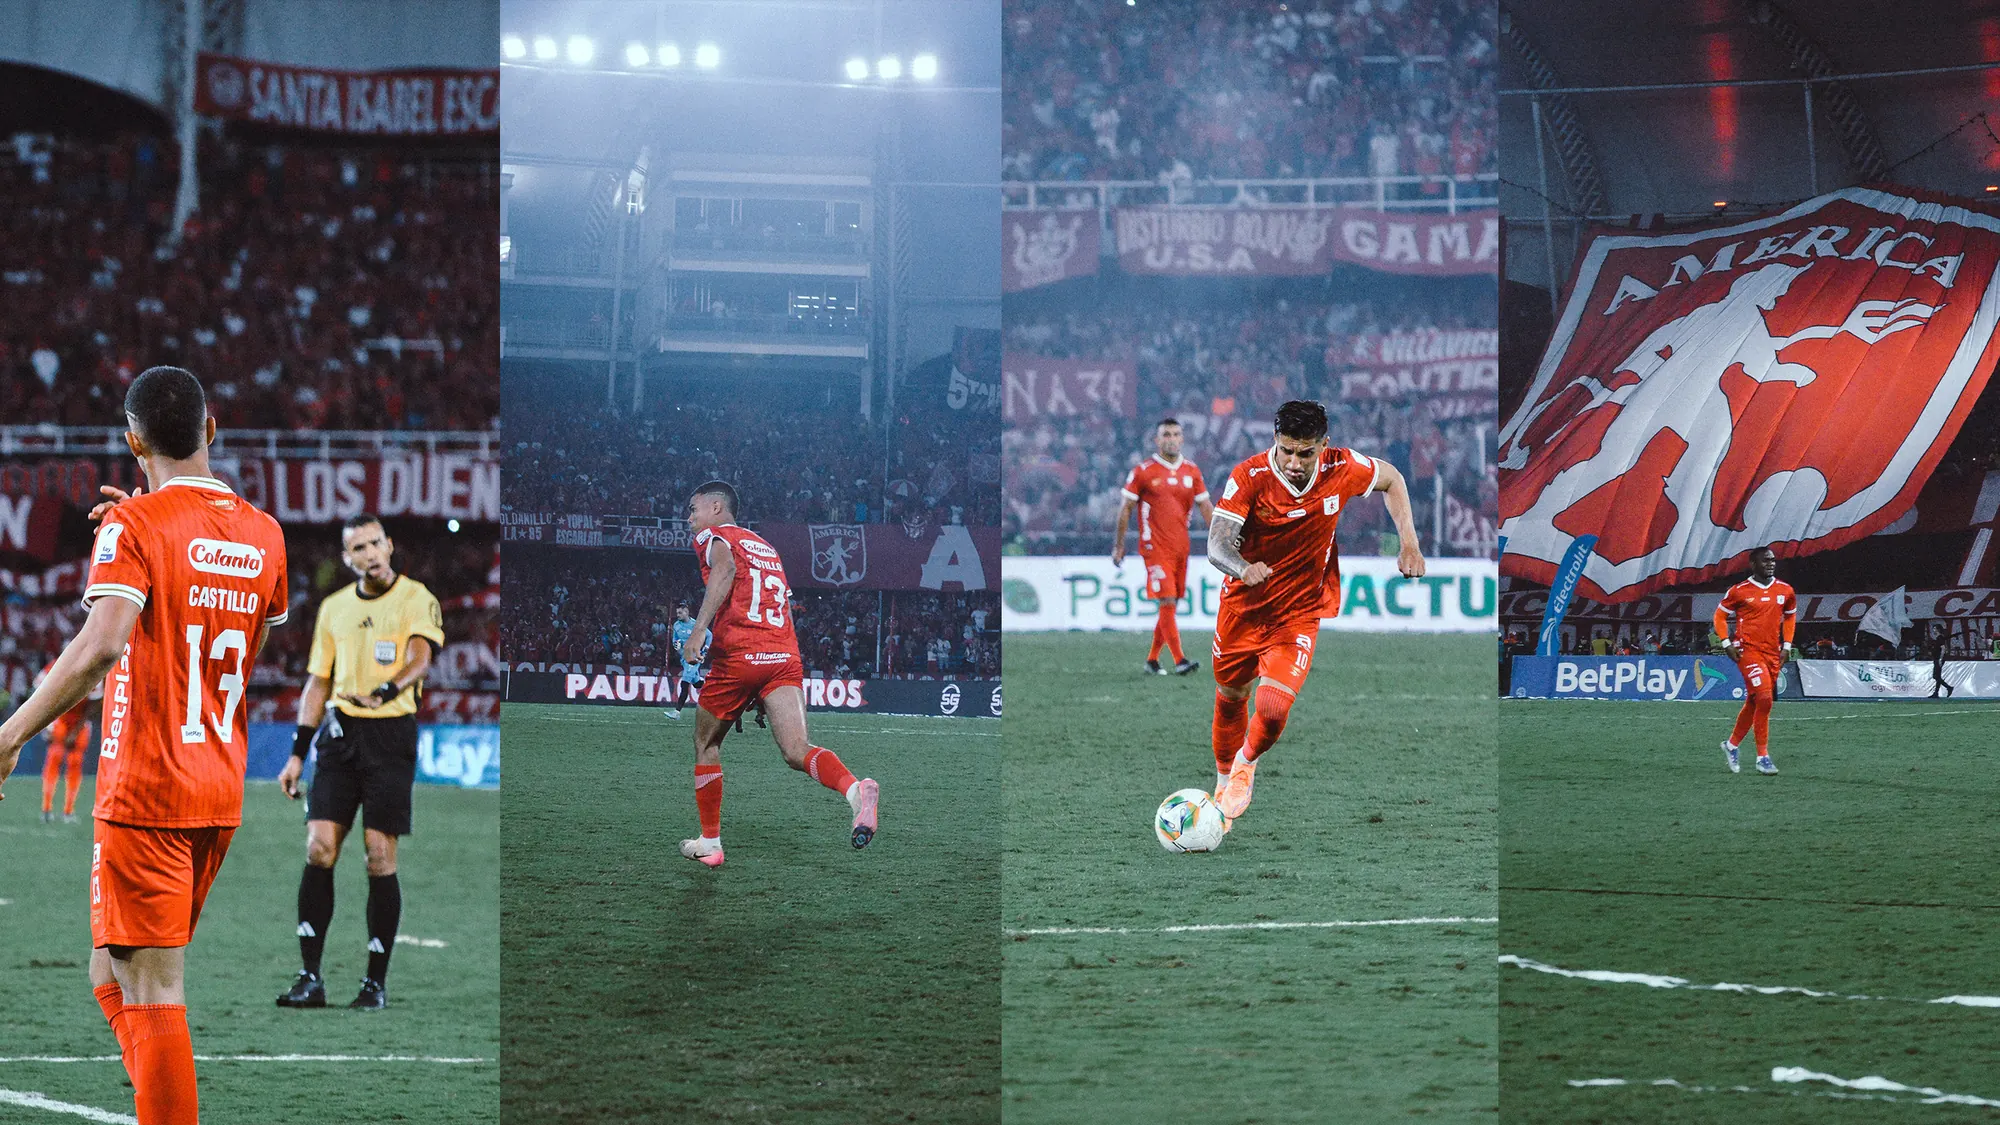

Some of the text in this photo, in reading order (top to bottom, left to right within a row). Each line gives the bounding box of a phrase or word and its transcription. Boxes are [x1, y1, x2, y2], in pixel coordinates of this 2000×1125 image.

[250, 67, 343, 129] SANTA
[348, 77, 437, 133] ISABEL
[1603, 226, 1964, 315] AMERICA
[274, 460, 367, 523] LOS
[191, 544, 260, 571] Colanta
[814, 525, 860, 540] AMERICA
[920, 525, 986, 592] A
[188, 585, 259, 614] CASTILLO
[747, 568, 786, 628] 13
[1341, 574, 1496, 618] ACTU
[1554, 544, 1589, 613] Electrolit
[181, 624, 247, 744] 13
[1295, 649, 1309, 671] 10
[1556, 660, 1688, 699] BetPlay
[566, 673, 672, 702] PAUTA
